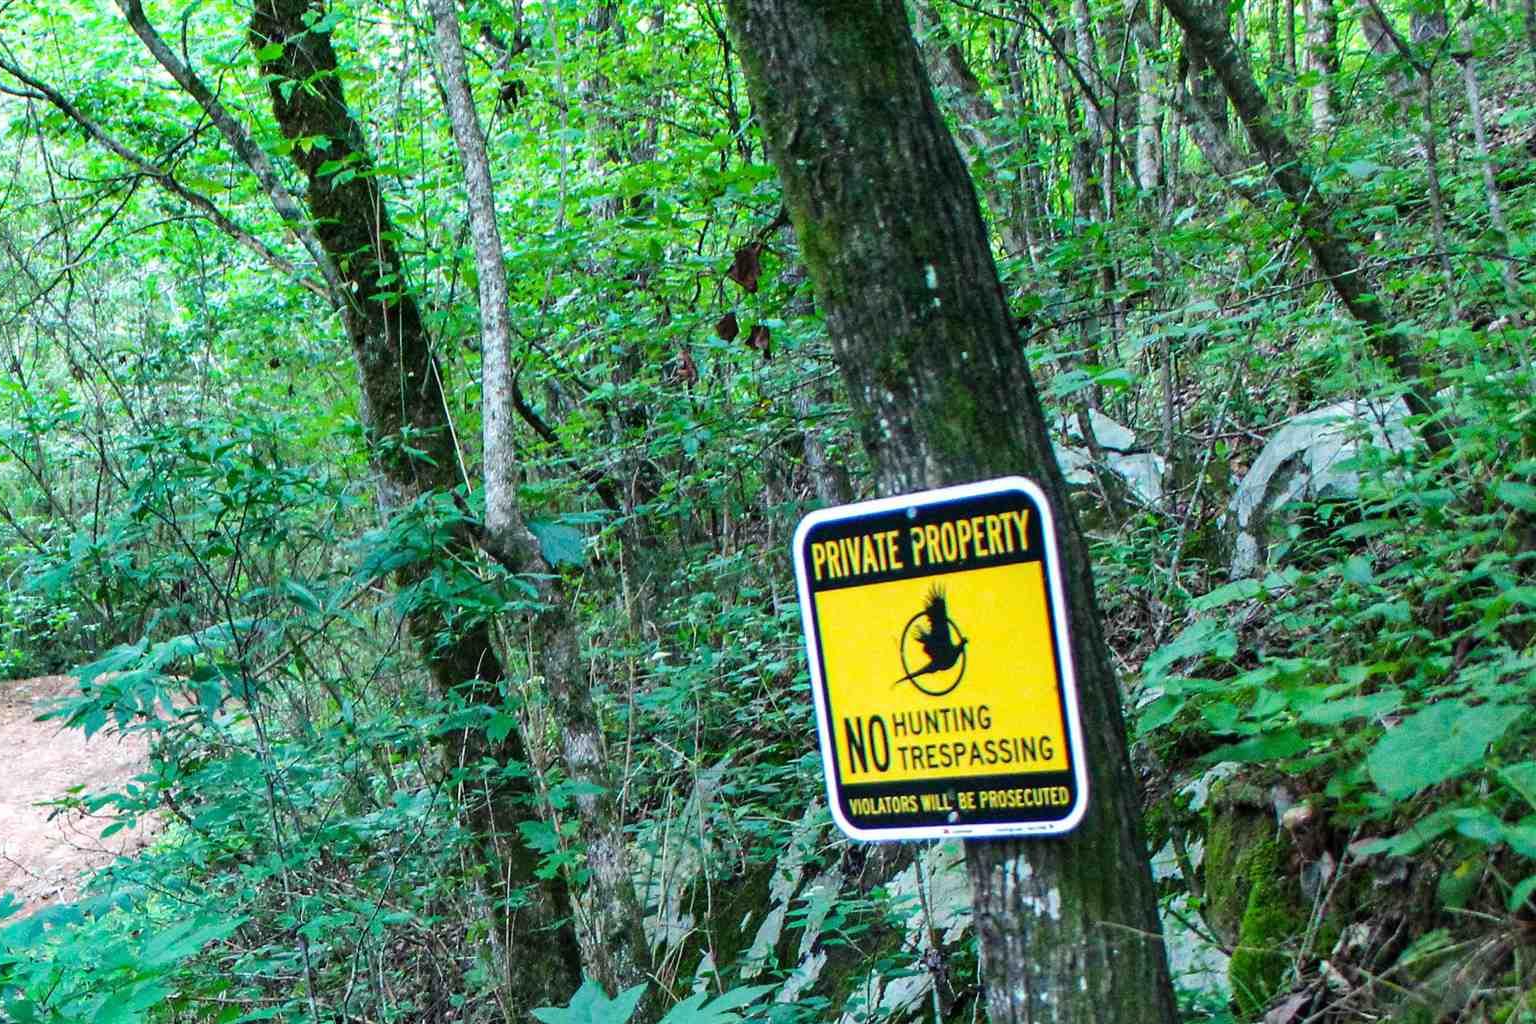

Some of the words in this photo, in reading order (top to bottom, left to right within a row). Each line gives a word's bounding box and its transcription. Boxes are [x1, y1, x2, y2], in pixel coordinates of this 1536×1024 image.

[811, 530, 904, 581] PRIVATE
[910, 509, 1031, 567] PROPERTY
[892, 705, 993, 737] HUNTING
[843, 714, 891, 774] NO
[897, 735, 1054, 770] TRESPASSING
[849, 795, 919, 816] VIOLATORS
[920, 793, 951, 812] WILL
[957, 790, 977, 809] BE
[980, 786, 1070, 809] PROSECUTED
